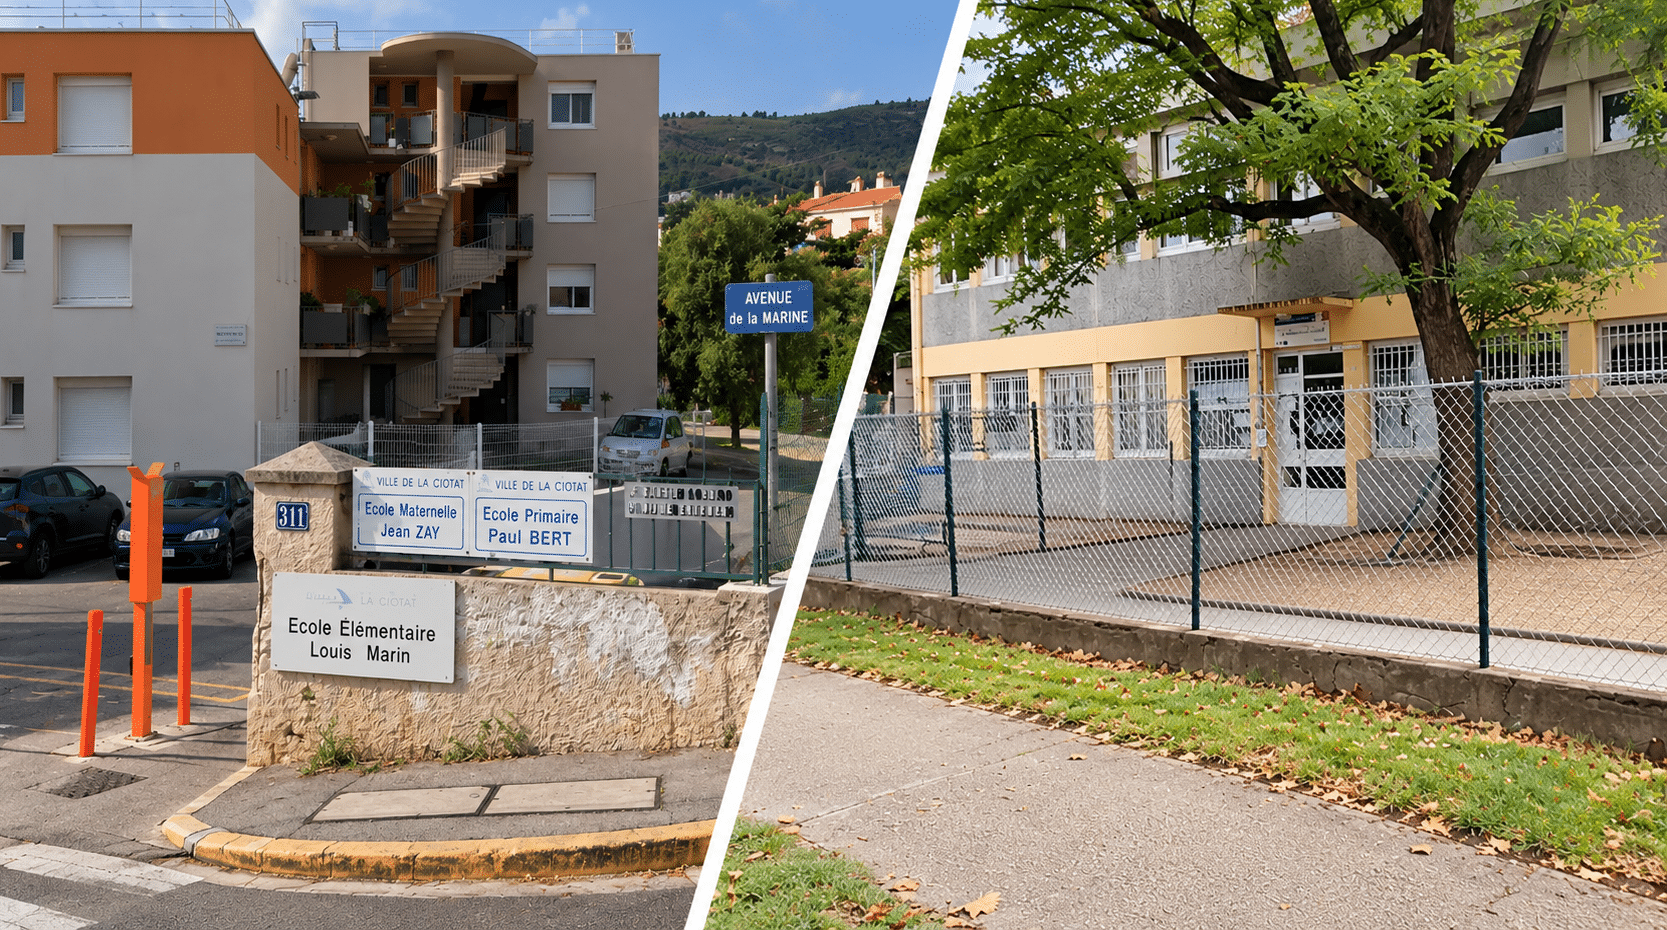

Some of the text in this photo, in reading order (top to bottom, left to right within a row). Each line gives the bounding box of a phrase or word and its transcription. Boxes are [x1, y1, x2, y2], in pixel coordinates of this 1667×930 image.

[745, 290, 792, 305] AVENUE
[729, 310, 809, 325] de la MARINE
[376, 477, 465, 489] VILLE DE LA CIOTAT
[495, 480, 588, 492] VILLE DE LA CIOTAT
[279, 505, 305, 527] 311
[365, 501, 457, 519] Ecole Maternelle
[483, 506, 579, 525] Ecole Primaire
[380, 523, 440, 540] Jean ZAY
[488, 528, 572, 546] Paul BERT
[288, 617, 436, 642] Ecole Élémentaire
[310, 641, 410, 664] Louis Marin
